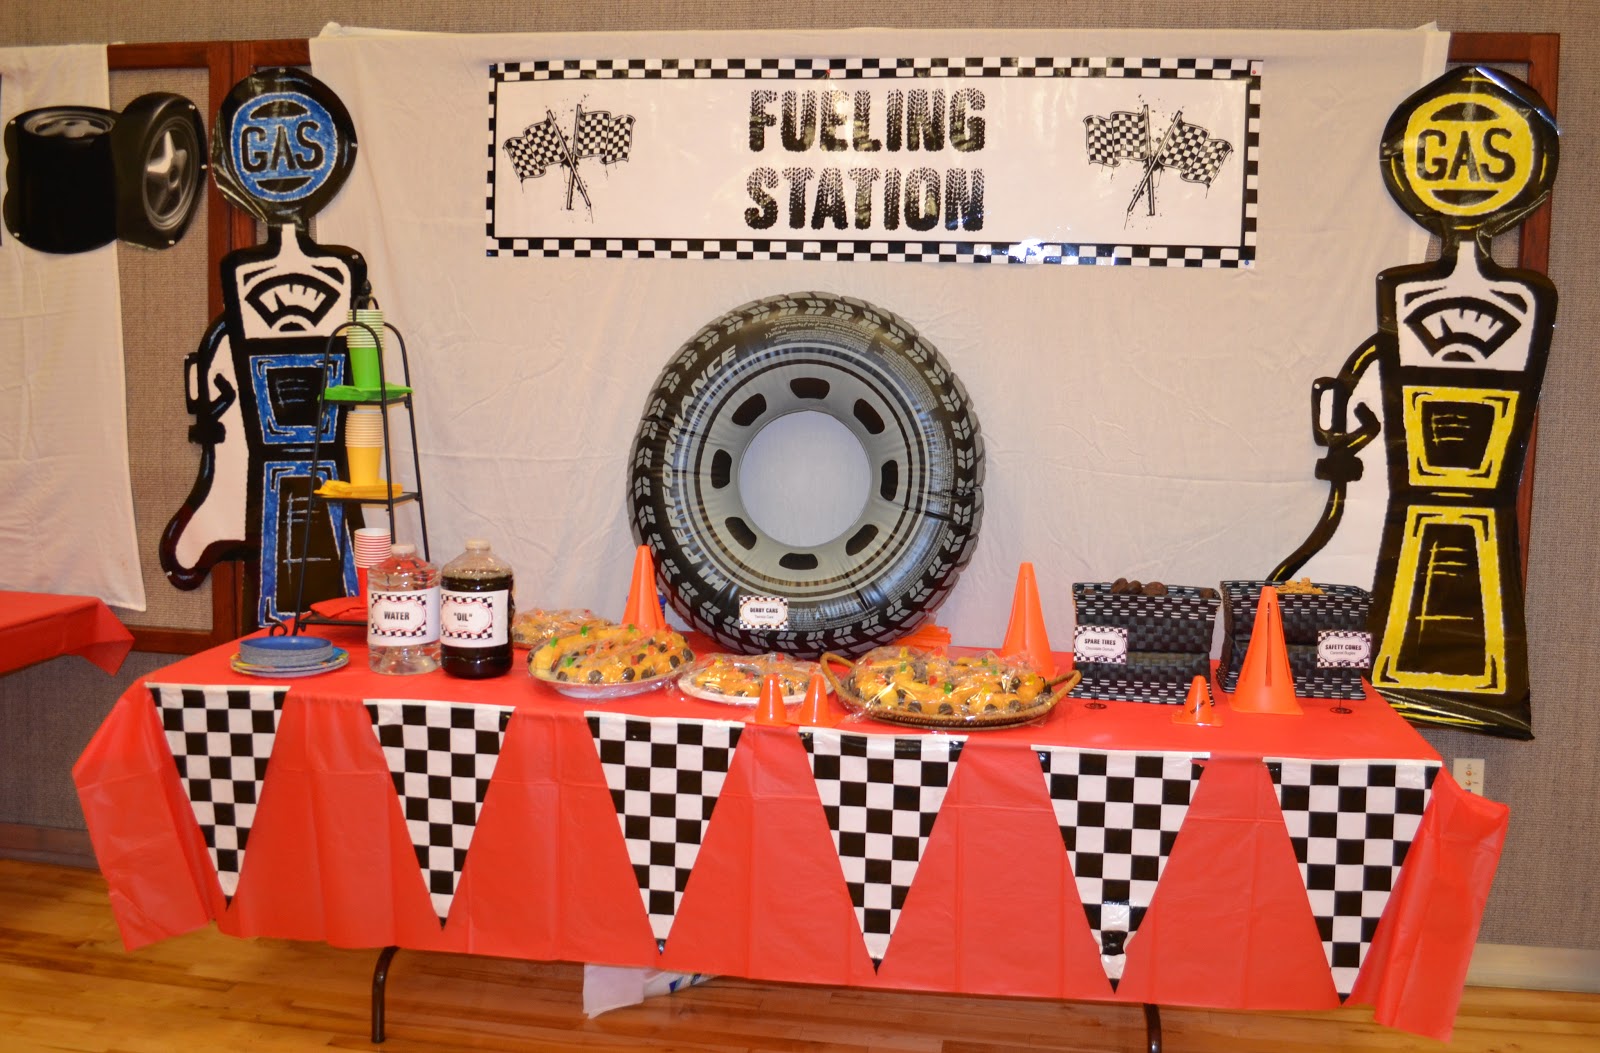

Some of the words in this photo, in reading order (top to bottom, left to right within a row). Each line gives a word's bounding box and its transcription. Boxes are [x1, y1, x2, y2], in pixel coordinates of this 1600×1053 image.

[241, 121, 324, 173] GAS
[749, 88, 986, 152] FUELING
[1417, 127, 1516, 183] GAS
[744, 167, 985, 231] STATION
[662, 344, 737, 565] PERFORMANCE
[383, 611, 410, 621] WATER
